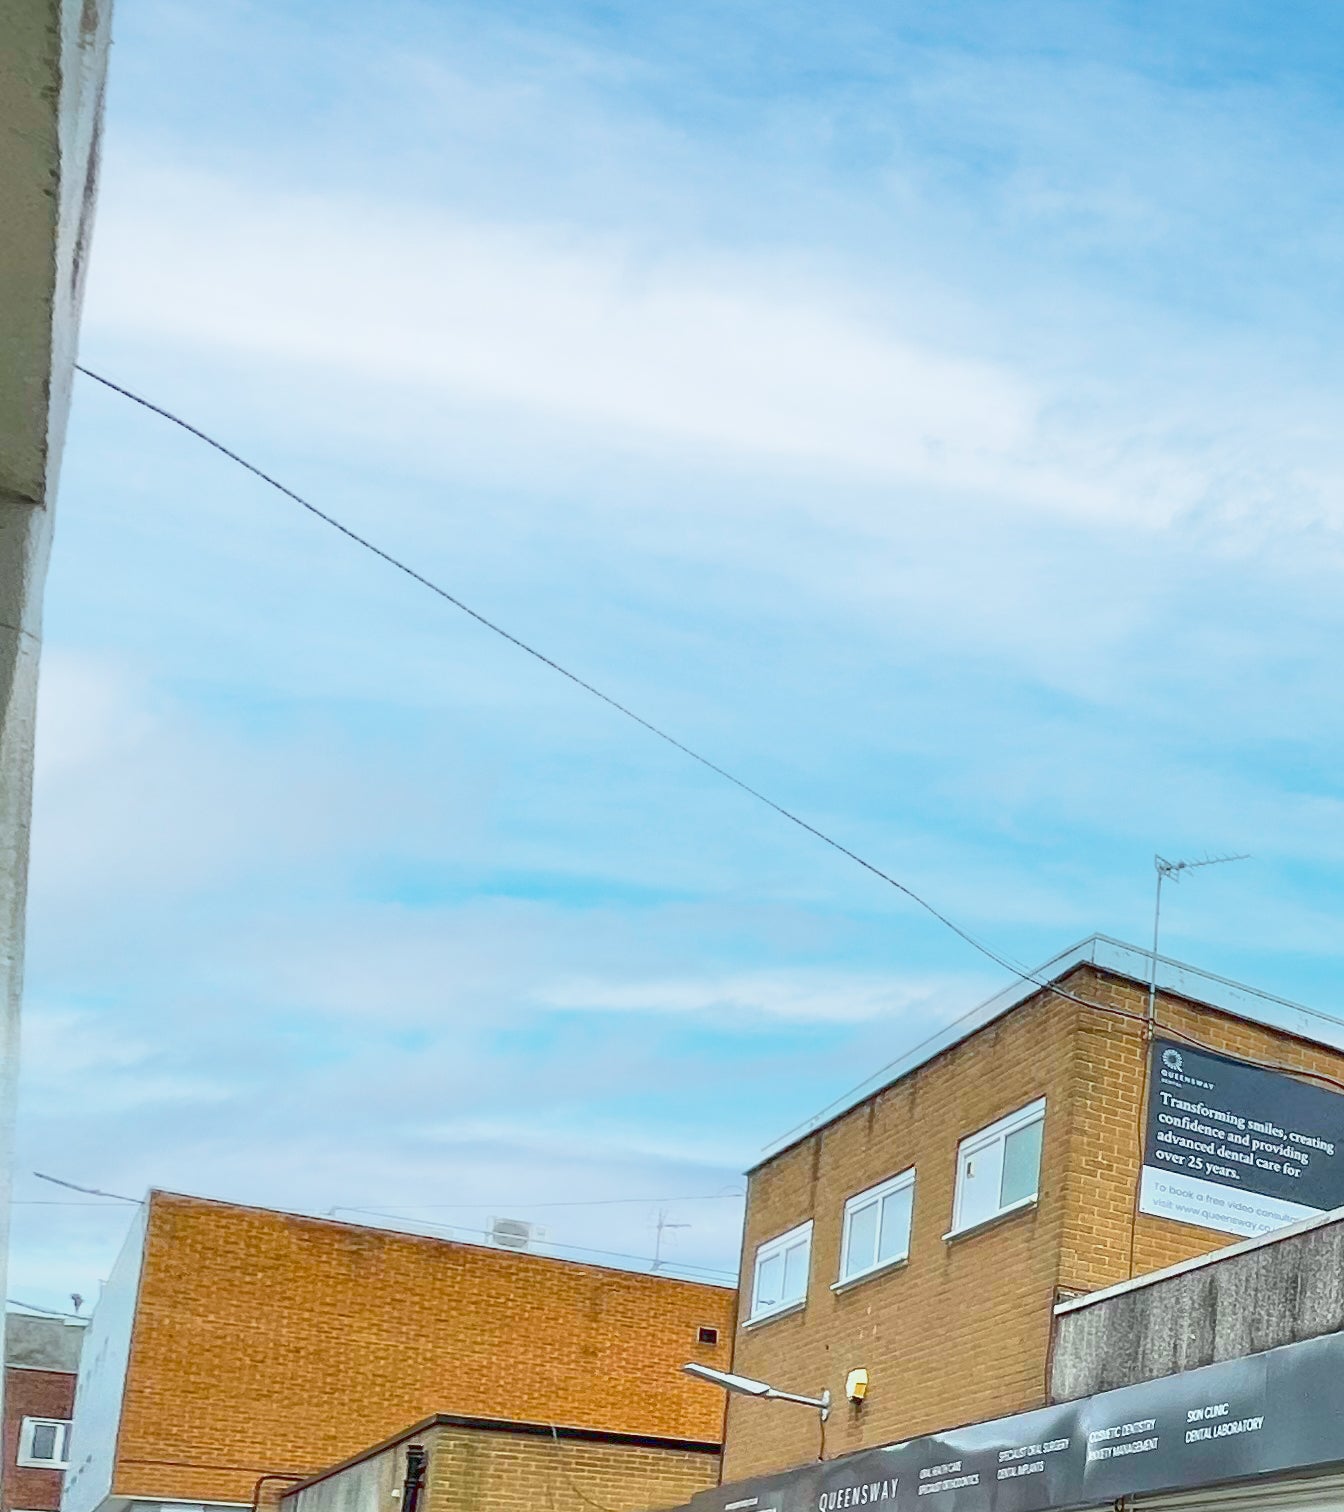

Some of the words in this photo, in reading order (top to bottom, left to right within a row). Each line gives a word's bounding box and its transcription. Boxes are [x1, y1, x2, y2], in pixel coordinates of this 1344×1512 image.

[1160, 1069, 1215, 1091] QUEENSWAY
[1160, 1091, 1246, 1130] Transforming
[1247, 1121, 1288, 1142] smiles,
[1289, 1131, 1335, 1155] creating
[1158, 1113, 1225, 1140] confidence
[1227, 1131, 1250, 1147] and
[1251, 1138, 1309, 1165] providing
[1156, 1150, 1185, 1165] over
[1187, 1155, 1203, 1170] 25
[1205, 1160, 1240, 1180] years.
[1157, 1130, 1215, 1155] advanced
[1216, 1145, 1254, 1166] dental
[1255, 1158, 1281, 1173] care
[1282, 1162, 1301, 1178] for
[1153, 1198, 1173, 1210] visit
[1154, 1182, 1167, 1194] To
[1169, 1182, 1194, 1200] book
[1196, 1193, 1204, 1203] a
[1206, 1194, 1226, 1209] free
[1227, 1199, 1254, 1214] video
[1186, 1409, 1203, 1423] SKIN
[1204, 1402, 1229, 1421] CLINIC
[1185, 1428, 1212, 1444] DENTAL
[1214, 1416, 1265, 1437] LABORATORY
[1112, 1438, 1159, 1458] MANAGEMENT
